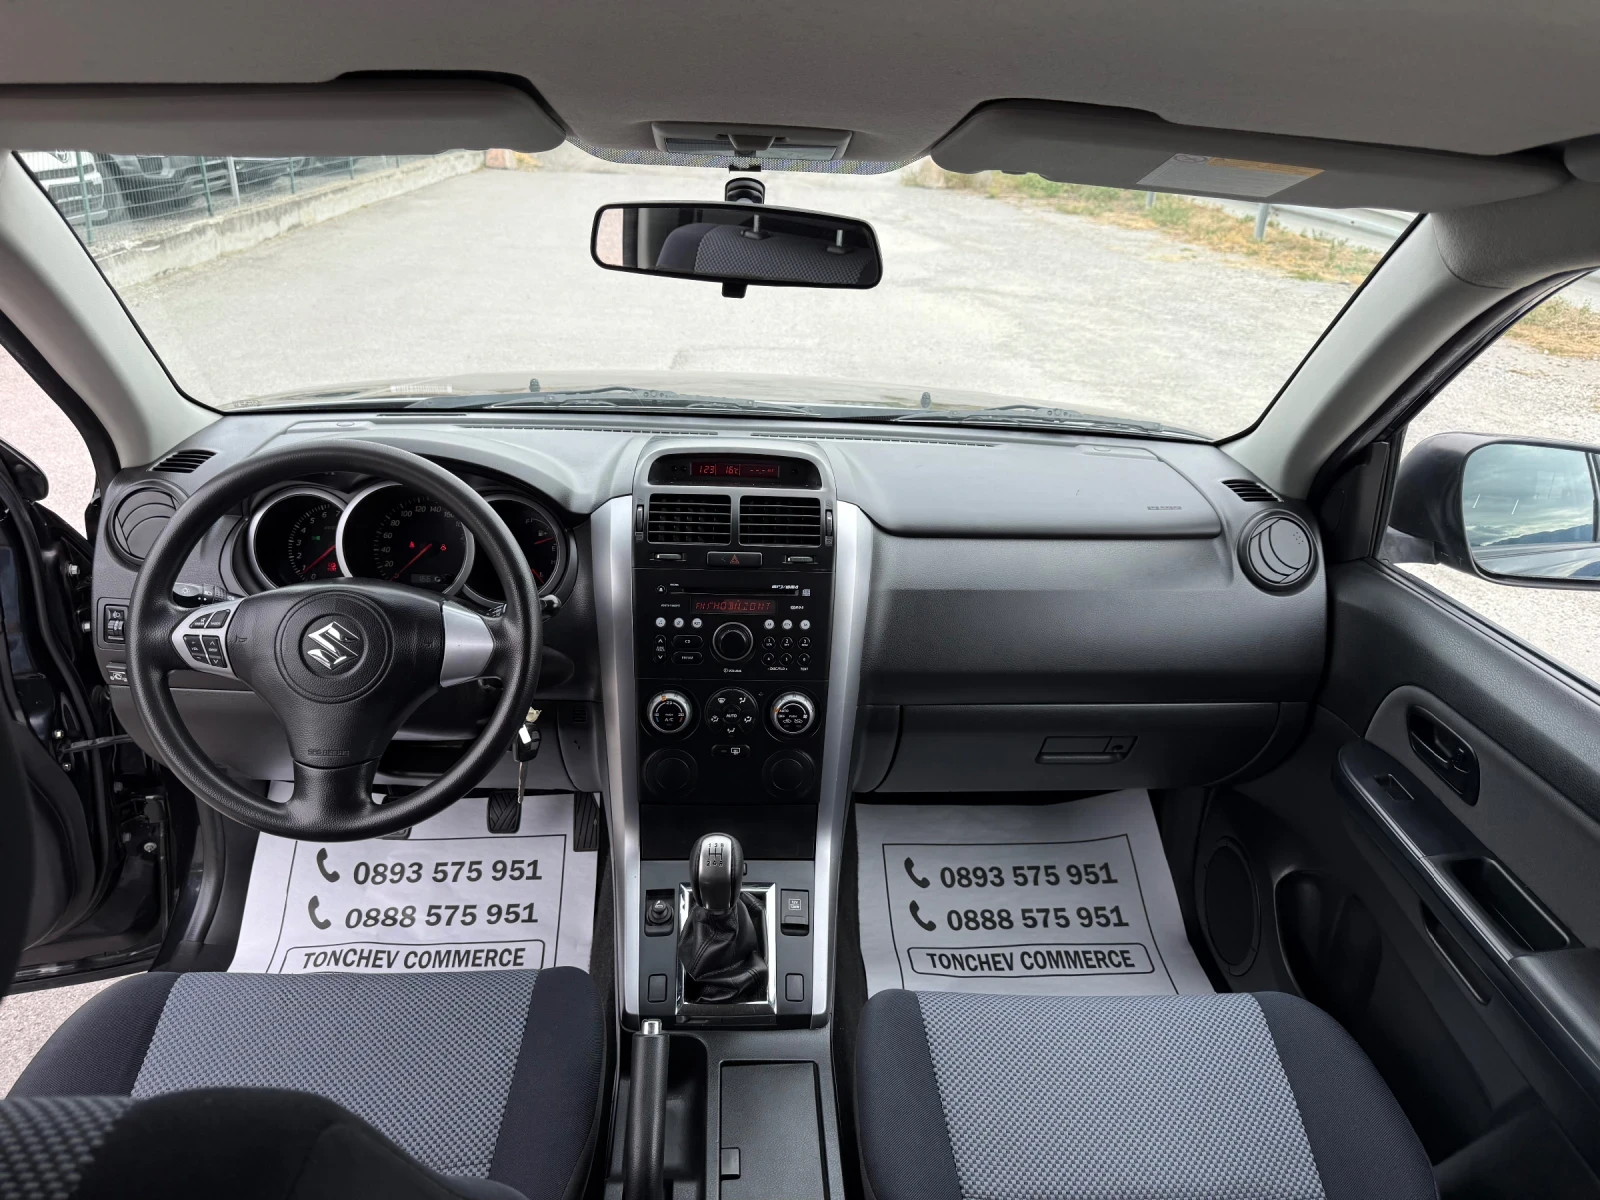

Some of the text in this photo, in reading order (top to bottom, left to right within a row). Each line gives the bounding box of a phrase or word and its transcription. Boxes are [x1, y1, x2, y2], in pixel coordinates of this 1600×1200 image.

[415, 505, 427, 513] 120
[390, 519, 401, 527] 80
[296, 539, 302, 547] 3
[353, 859, 543, 886] 0893 575 951
[940, 862, 1119, 889] 0893 575 951
[345, 903, 539, 929] 0888 575 951
[946, 905, 1130, 931] 0888 575 951
[302, 947, 526, 970] TONCHEV COMMERCE
[926, 949, 1136, 971] TONCHEV COMMERCE
